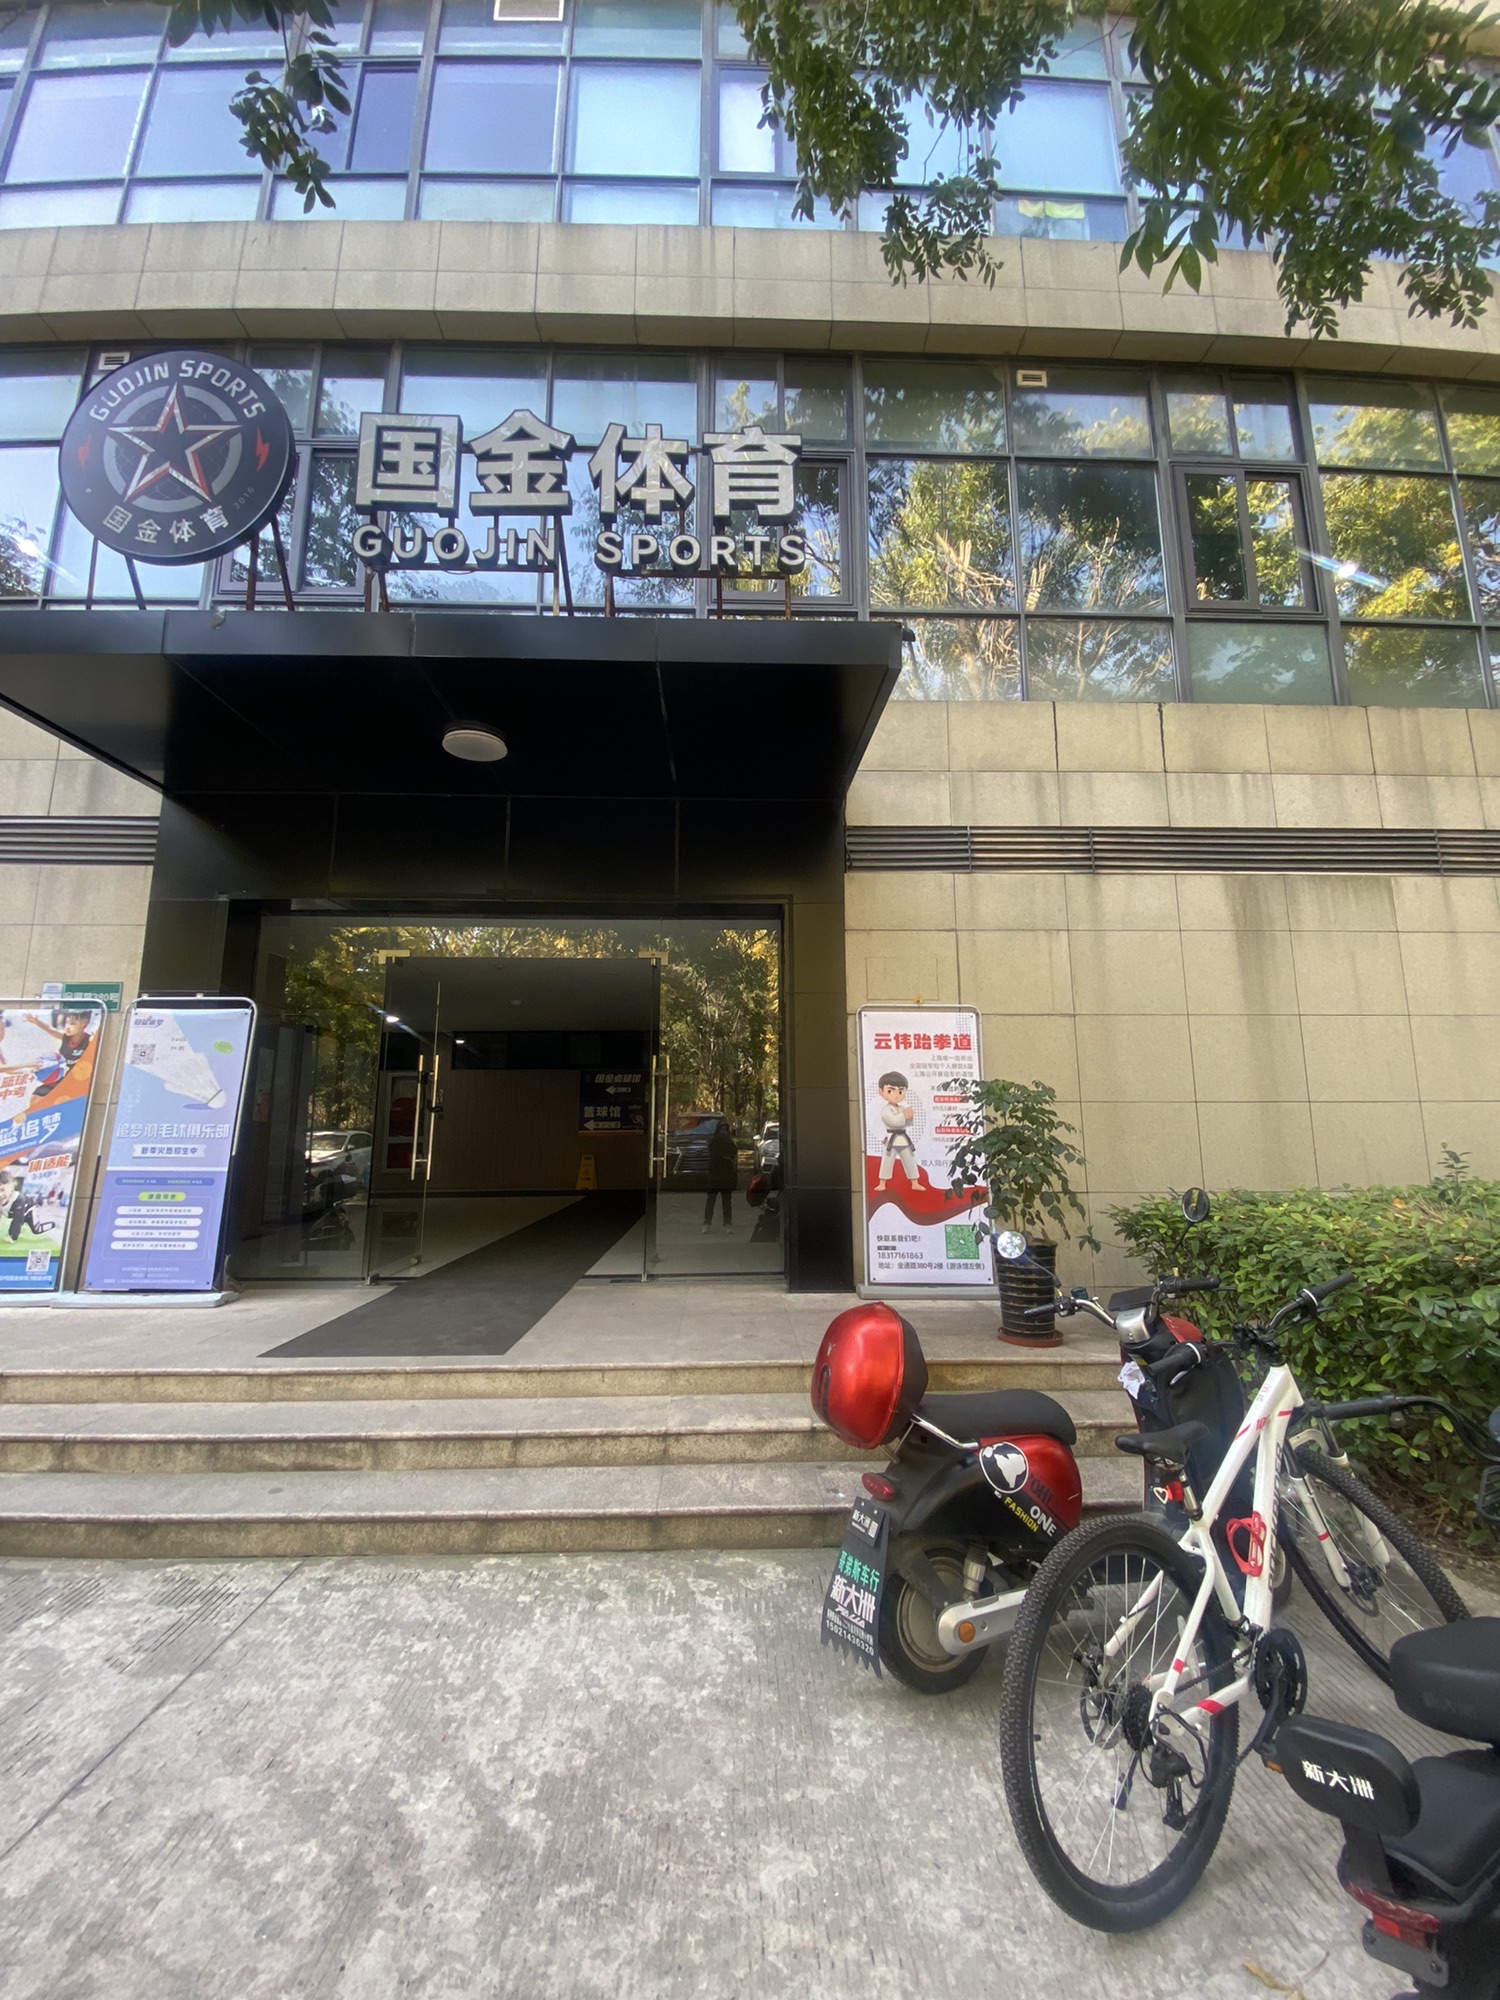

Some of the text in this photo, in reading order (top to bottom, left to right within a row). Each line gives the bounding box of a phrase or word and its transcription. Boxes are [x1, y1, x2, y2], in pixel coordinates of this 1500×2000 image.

[89, 359, 267, 422] GUOJIN SPORTS
[355, 409, 803, 519] 国金体育
[103, 504, 229, 544] 国金体育
[352, 524, 805, 569] GUOJIN SPORTS
[874, 1033, 972, 1050] 云伟跆拳道
[116, 1123, 230, 1139] 追梦羽毛球俱乐部
[584, 1106, 621, 1118] 篮球馆
[1004, 1497, 1039, 1532] FASHION
[1030, 1505, 1057, 1537] ONE
[830, 1574, 876, 1624] 新大洲
[1301, 1759, 1375, 1800] 新大洲
